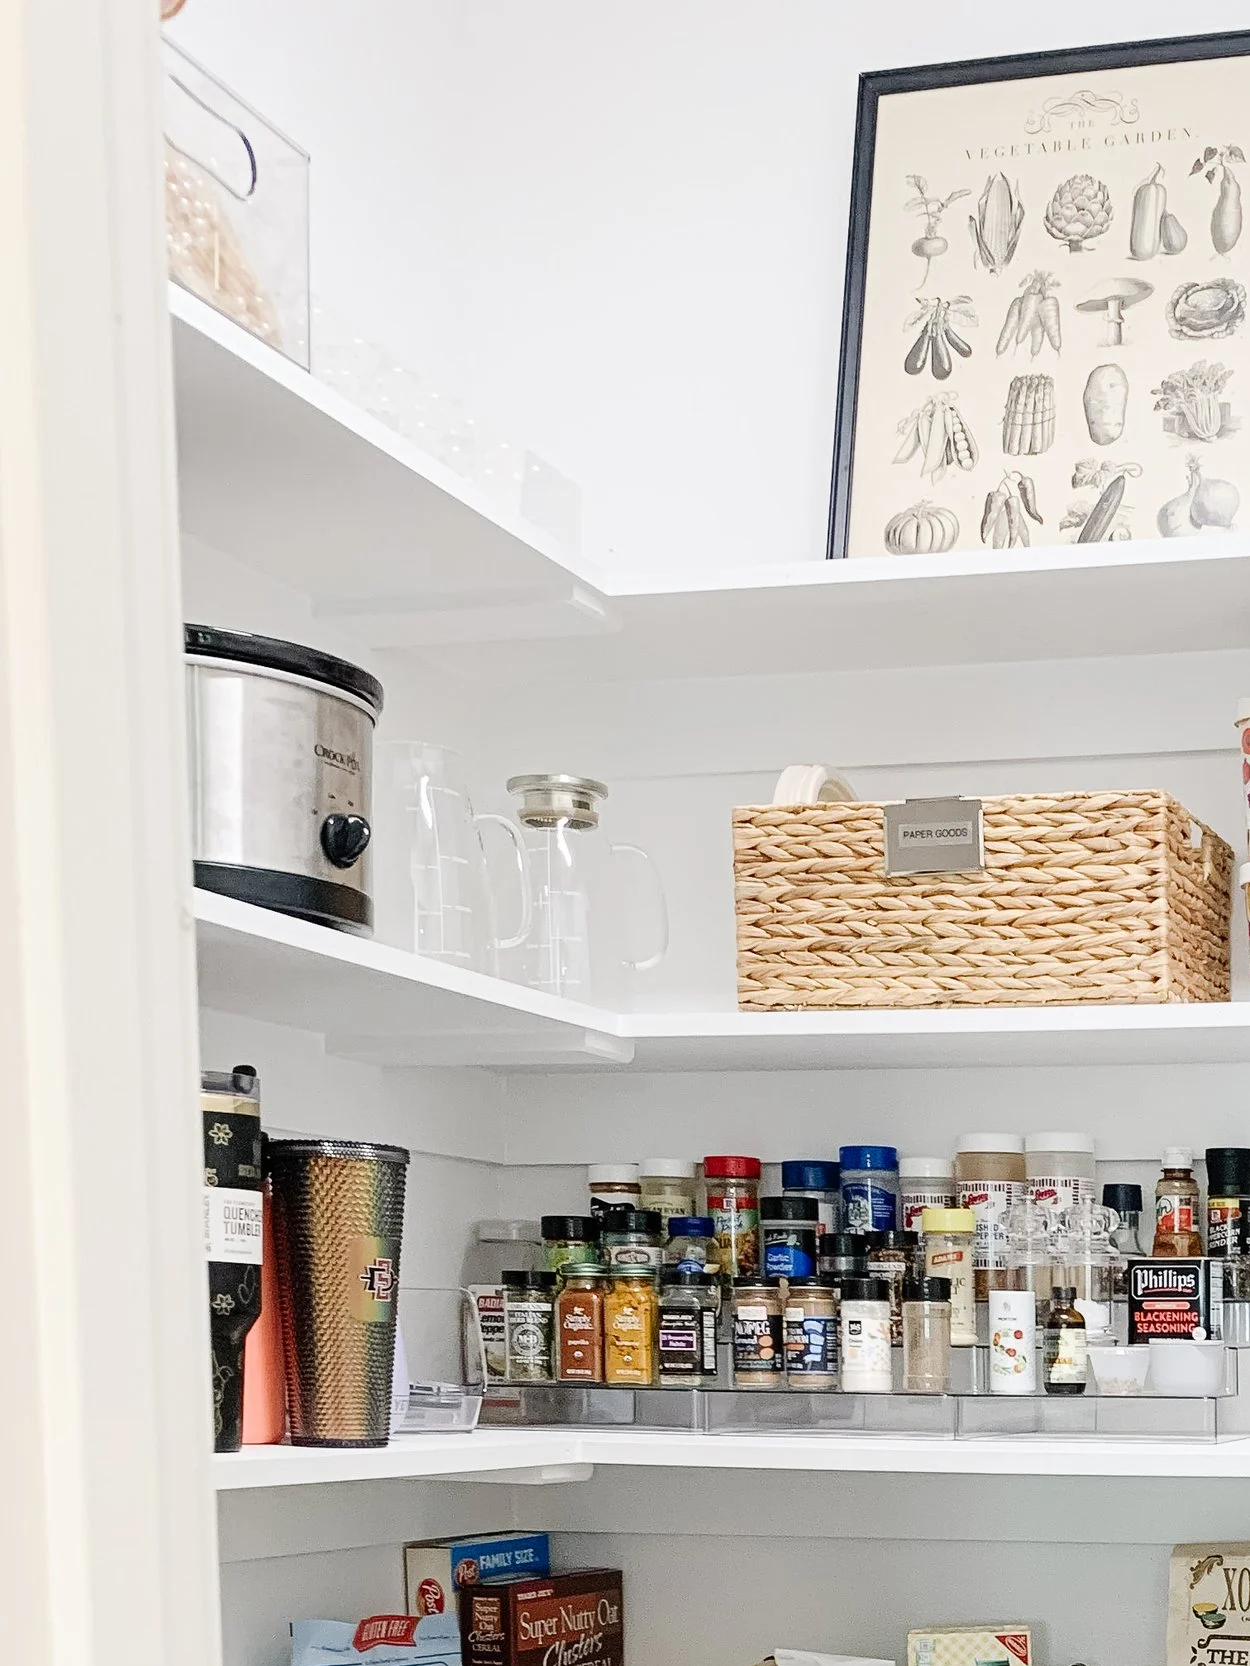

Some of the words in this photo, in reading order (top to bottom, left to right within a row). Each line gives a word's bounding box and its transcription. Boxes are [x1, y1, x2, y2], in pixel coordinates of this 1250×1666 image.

[1068, 119, 1096, 130] THE
[965, 137, 1092, 160] VEGETABLE
[1104, 127, 1200, 148] GARDEN.
[903, 829, 933, 839] PAPER
[935, 827, 968, 838] GOODS
[1135, 1269, 1196, 1296] Phillips
[1133, 1311, 1199, 1322] BLACKENING
[1136, 1322, 1197, 1333] SEASONING
[479, 1553, 513, 1570] FAMILY
[515, 1549, 535, 1564] SIZE
[458, 1562, 477, 1583] Post
[422, 1584, 441, 1615] Post
[475, 1603, 499, 1613] Super
[520, 1611, 559, 1644] Super
[559, 1604, 596, 1634] Nutty
[597, 1599, 619, 1626] Oat
[361, 1619, 388, 1642] GLUTEN
[387, 1619, 411, 1637] FREE
[468, 1630, 506, 1643] Clusters
[472, 1643, 501, 1652] CEREAL
[1207, 1649, 1249, 1666] THE
